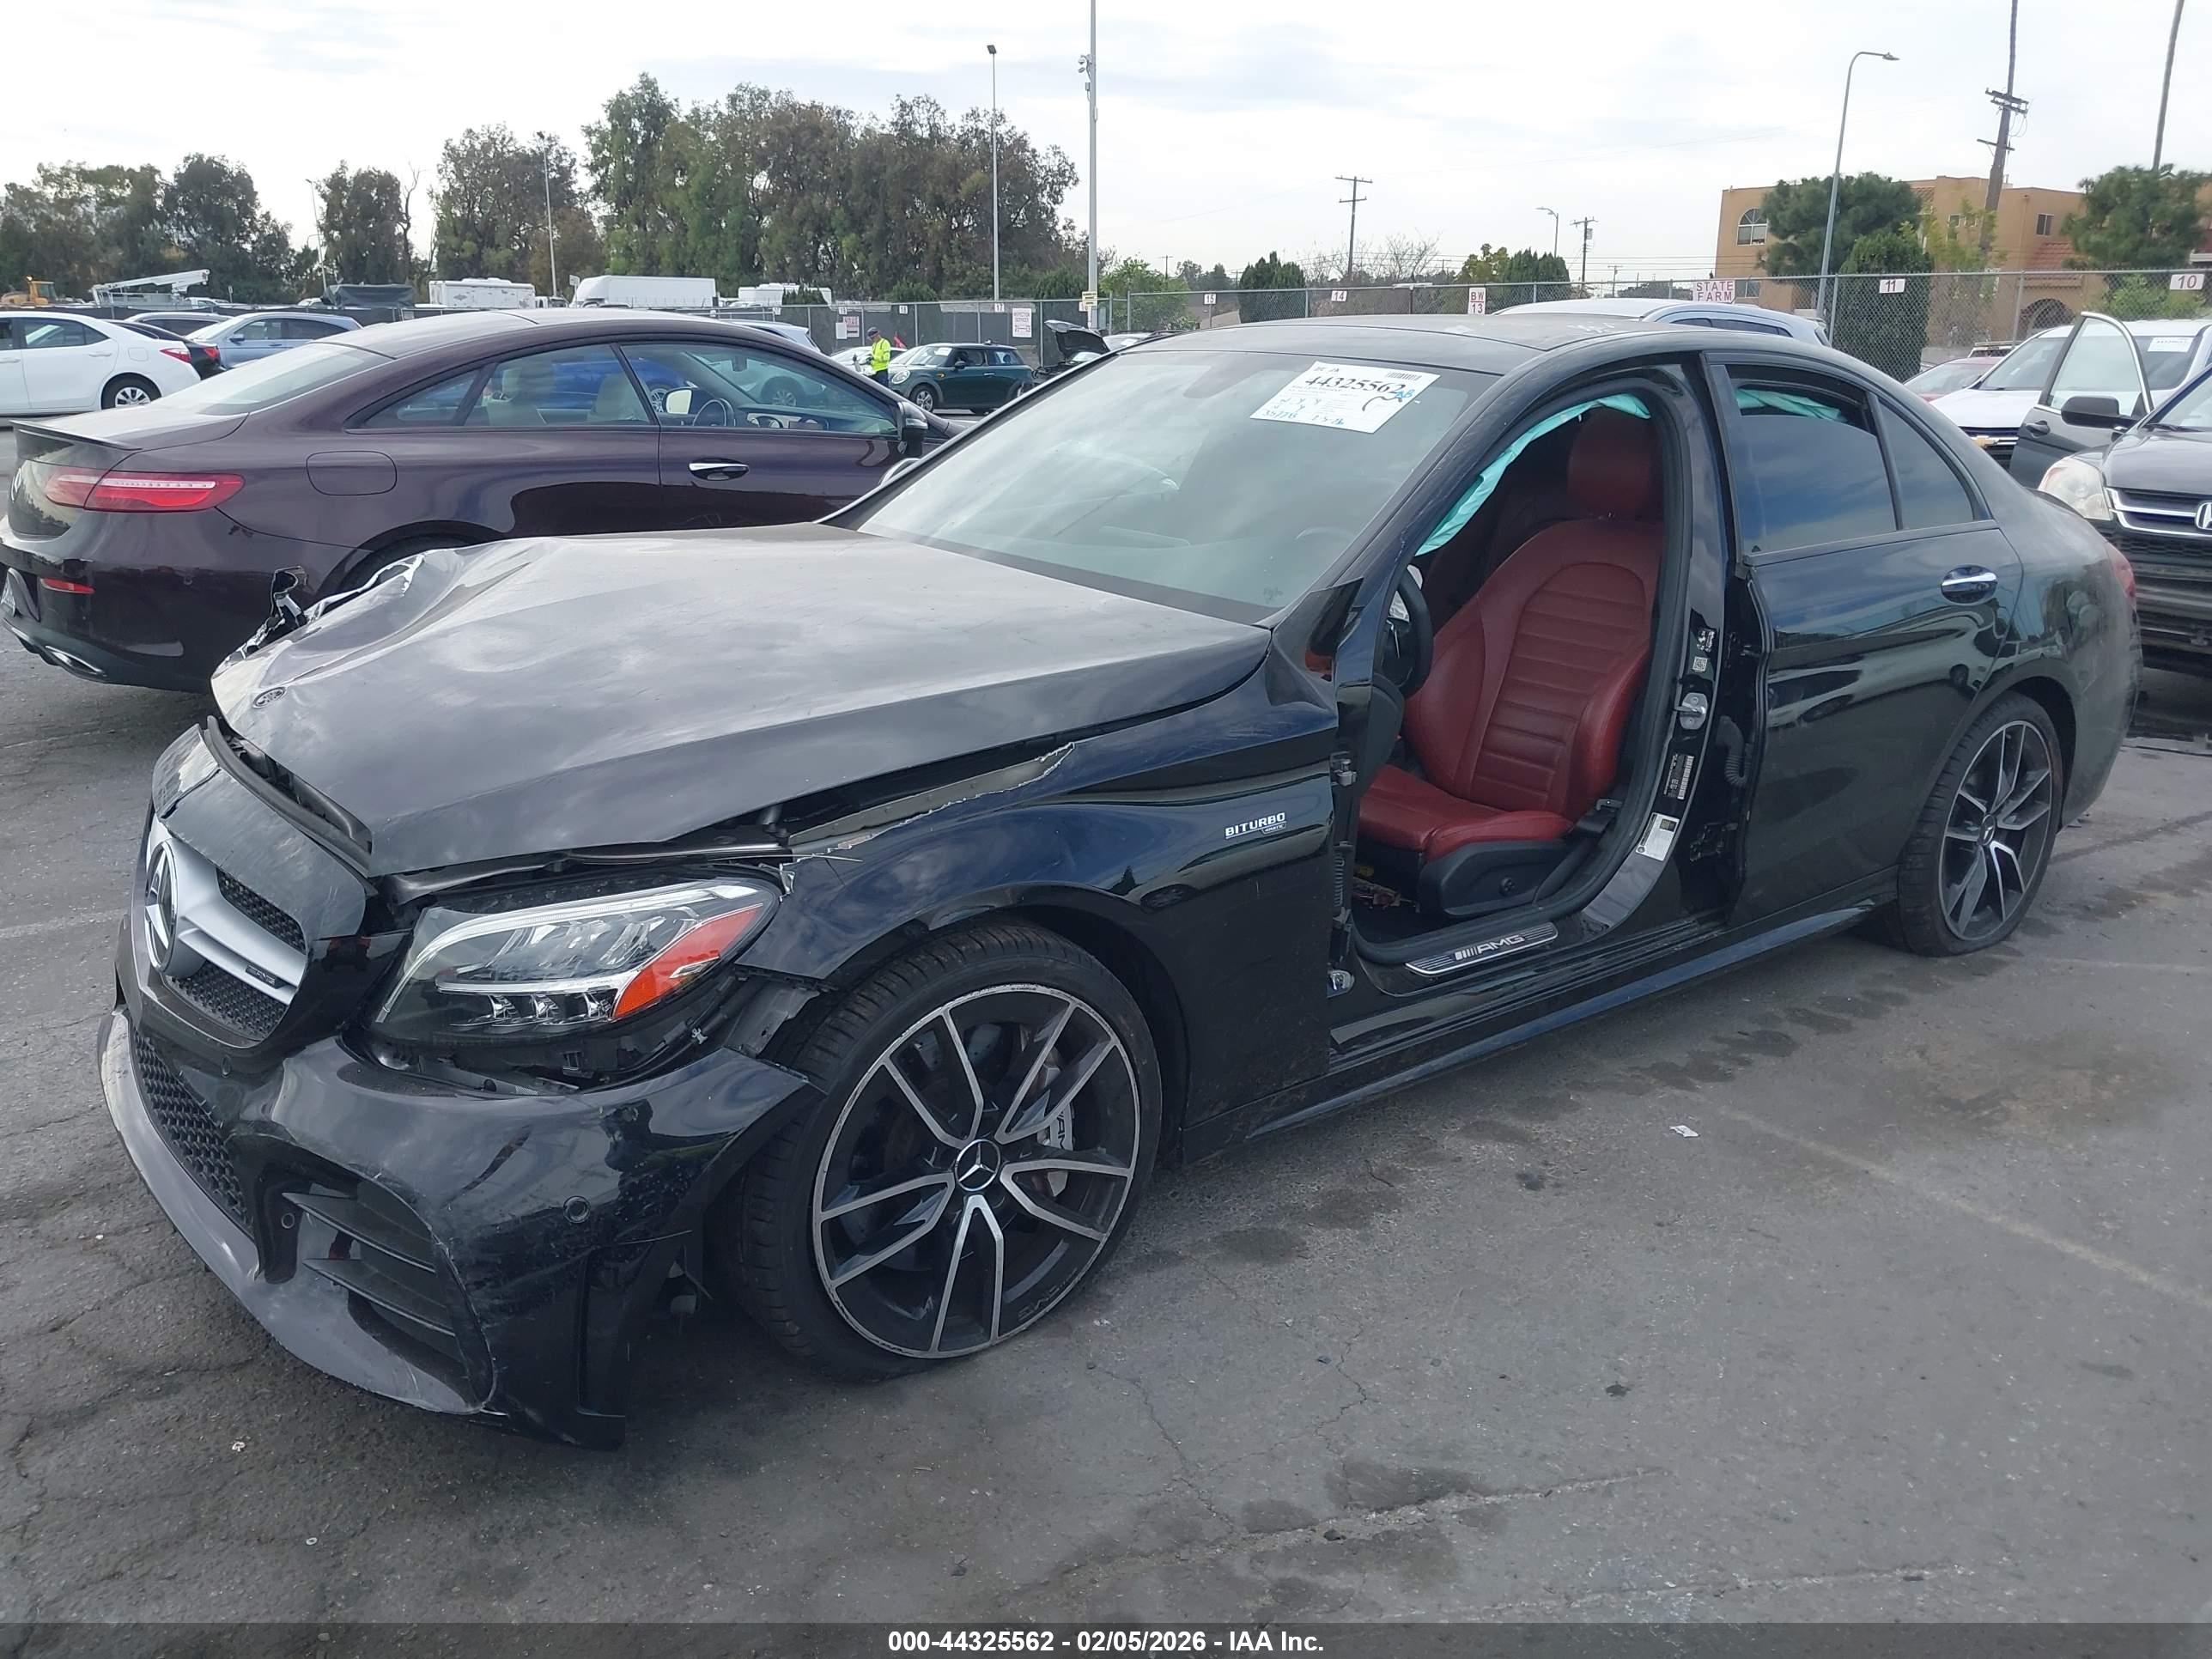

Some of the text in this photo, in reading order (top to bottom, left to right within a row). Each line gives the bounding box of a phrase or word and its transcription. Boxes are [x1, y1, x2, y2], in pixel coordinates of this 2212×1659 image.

[1696, 281, 1734, 291] STATE
[1885, 280, 1896, 292] 11
[2179, 275, 2197, 289] 10
[1206, 294, 1215, 304] 15
[1333, 290, 1345, 301] 14
[1470, 291, 1485, 301] BW
[1697, 291, 1732, 301] FARM
[1472, 303, 1483, 314] 13
[1305, 376, 1407, 394] 44325562
[1224, 812, 1286, 836] BITURBO
[1478, 934, 1526, 954] AMG
